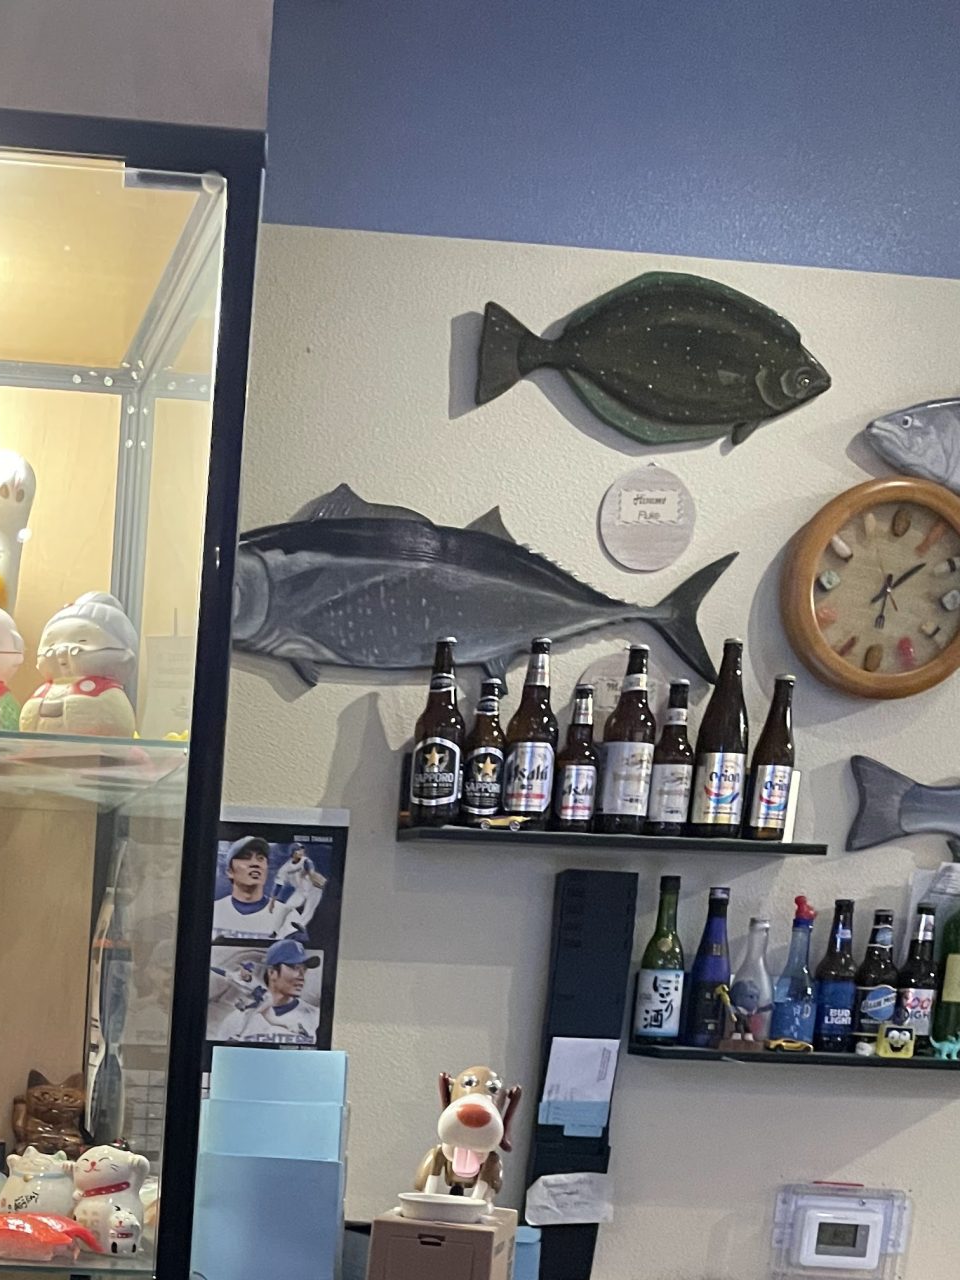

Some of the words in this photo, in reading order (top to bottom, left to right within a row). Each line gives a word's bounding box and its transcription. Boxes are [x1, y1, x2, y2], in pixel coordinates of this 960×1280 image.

[414, 772, 454, 784] SAPPORO
[709, 769, 740, 784] Orion
[829, 1009, 851, 1017] BUD
[824, 1016, 852, 1025] LIGHT
